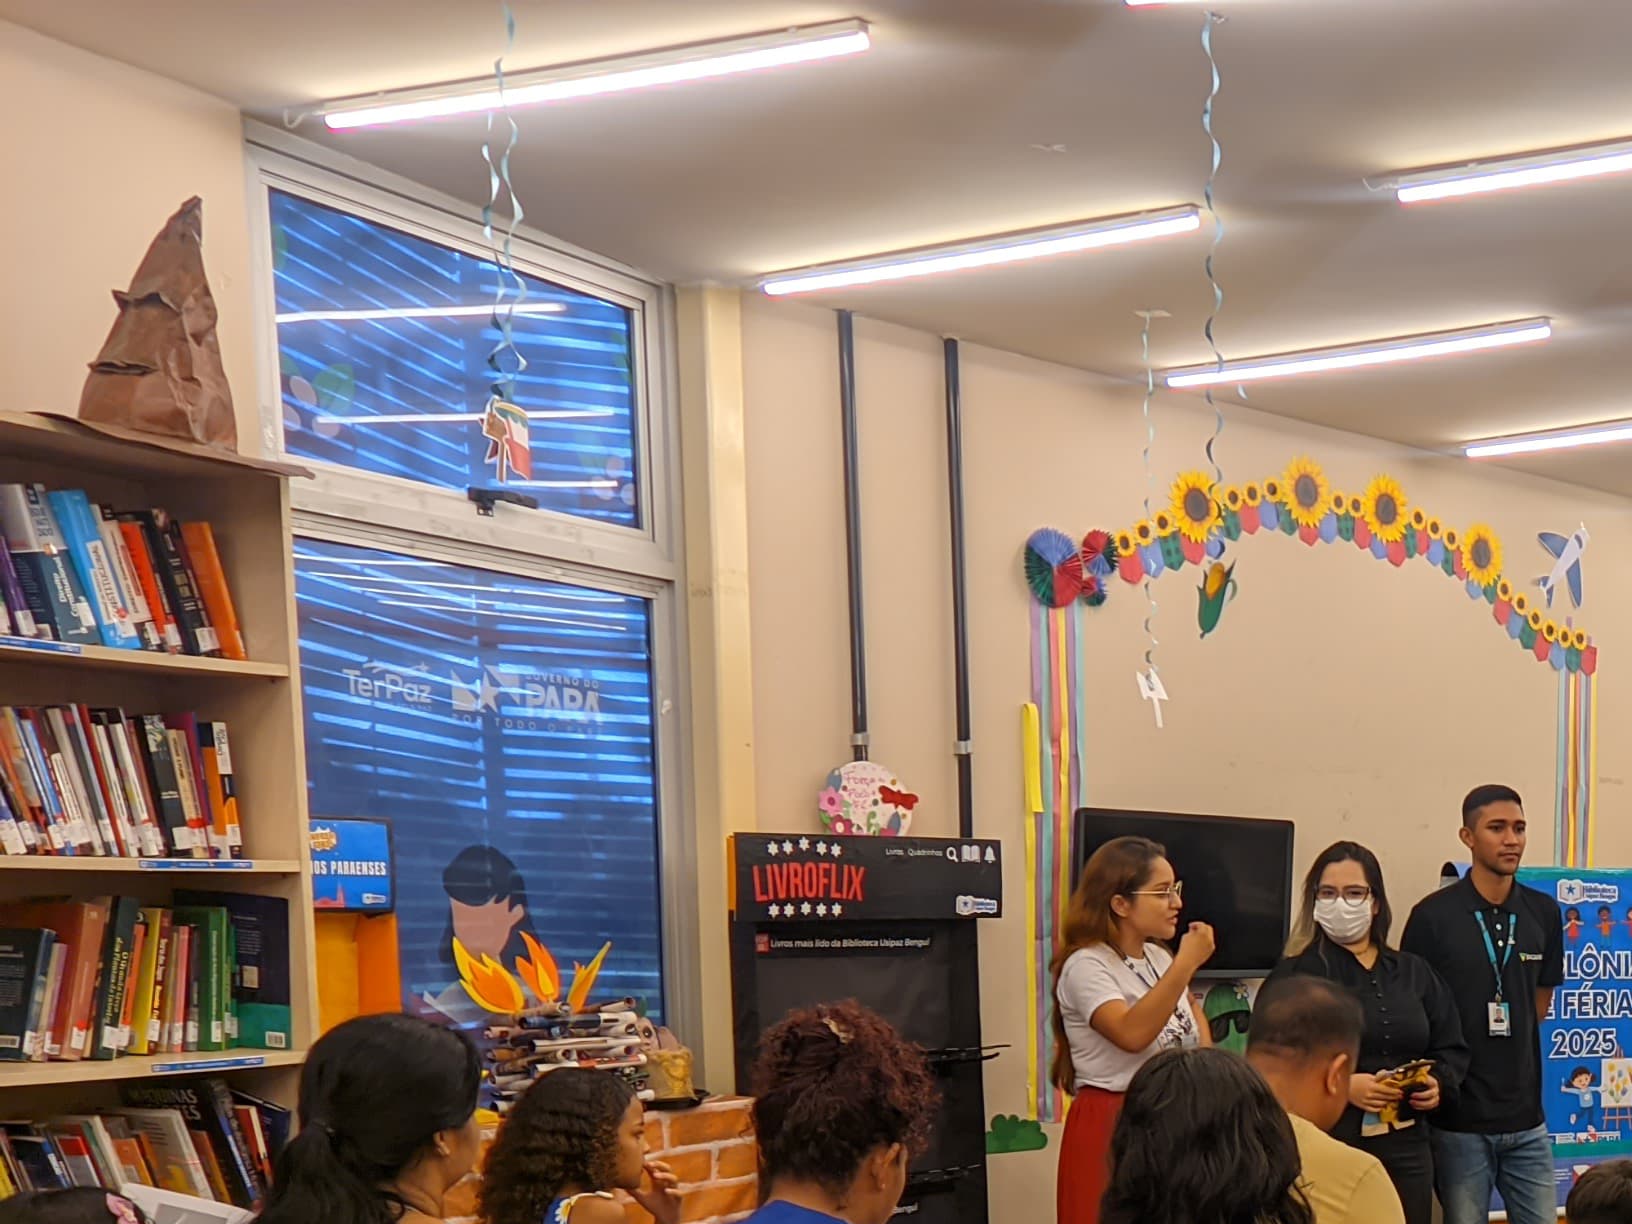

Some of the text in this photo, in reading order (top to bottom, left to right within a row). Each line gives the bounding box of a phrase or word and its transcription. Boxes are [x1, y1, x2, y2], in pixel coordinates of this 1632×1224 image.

[342, 669, 432, 703] TerPaz
[330, 860, 387, 876] PARAENSES
[752, 861, 865, 902] LIVROFLIX
[794, 939, 814, 947] mais
[842, 937, 879, 947] Biblioteca
[1549, 1028, 1617, 1058] 2025
